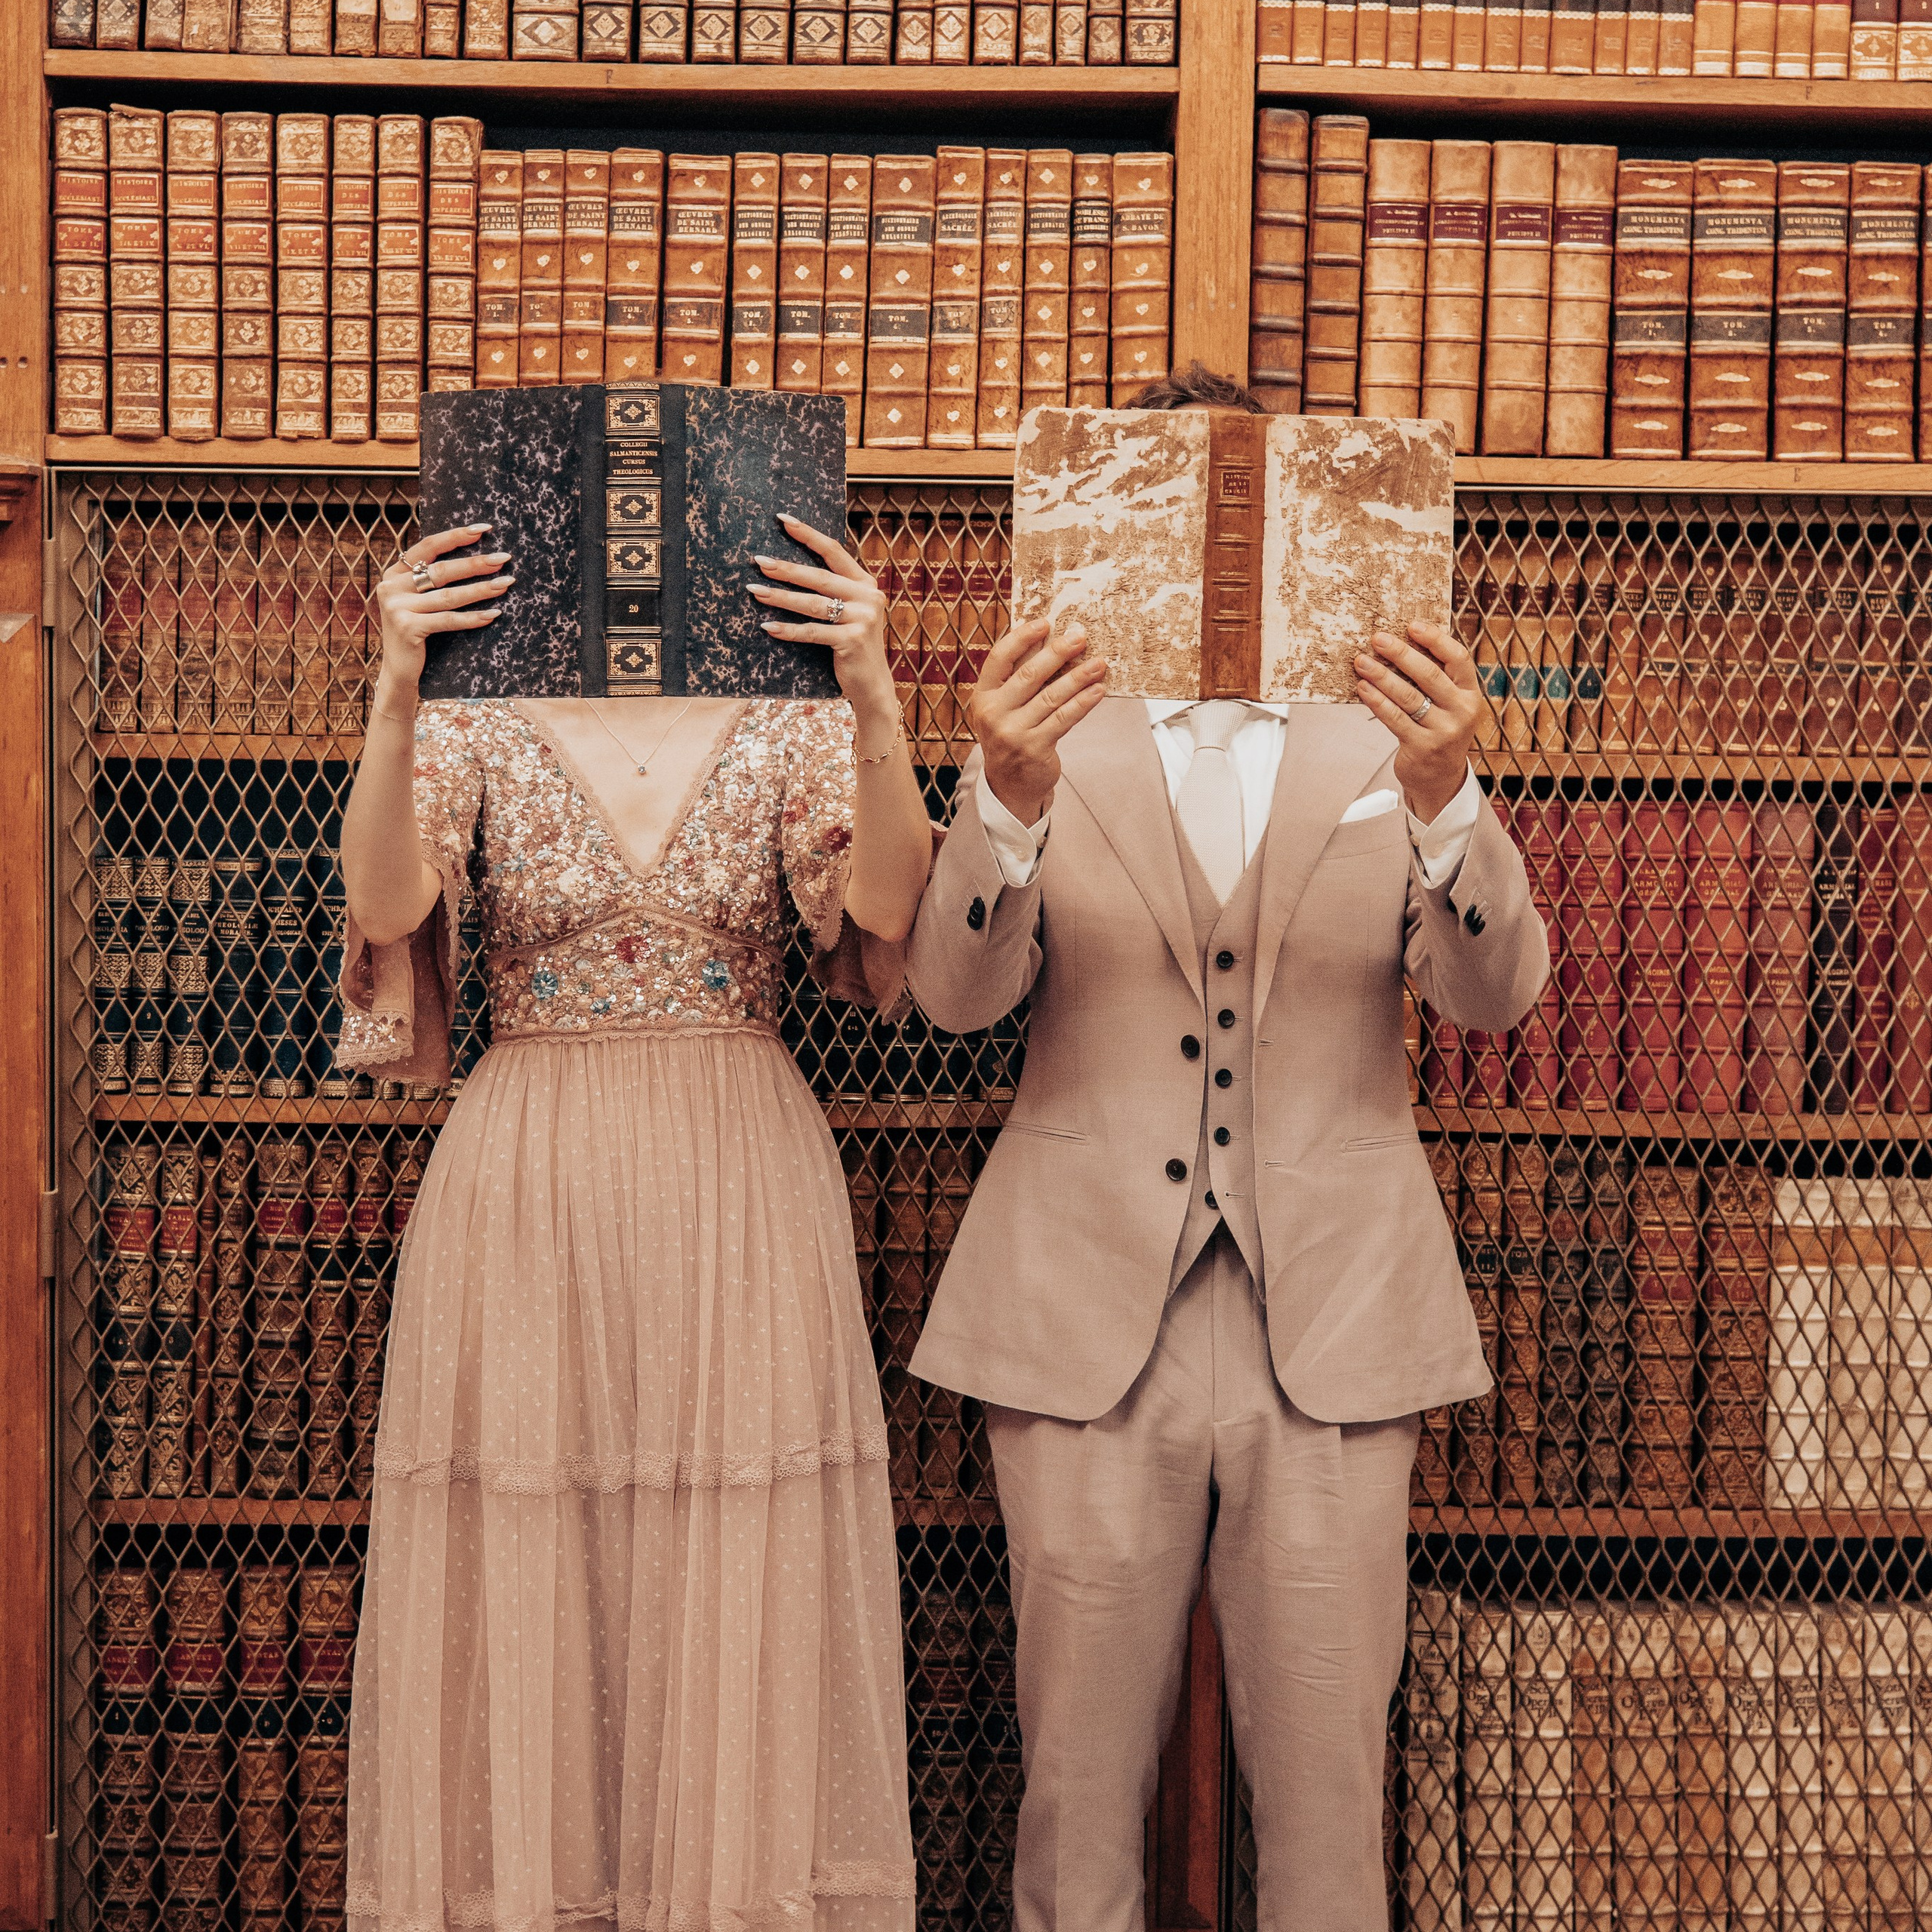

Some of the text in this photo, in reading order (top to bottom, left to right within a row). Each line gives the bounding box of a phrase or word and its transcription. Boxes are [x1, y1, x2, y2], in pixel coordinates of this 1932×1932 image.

[1631, 215, 1685, 224] MONUMENTA
[1707, 217, 1763, 226] MONUMENTA
[1787, 217, 1841, 226] MONUMENTA
[1861, 220, 1915, 229] MONUMENTA
[629, 604, 639, 613] 20
